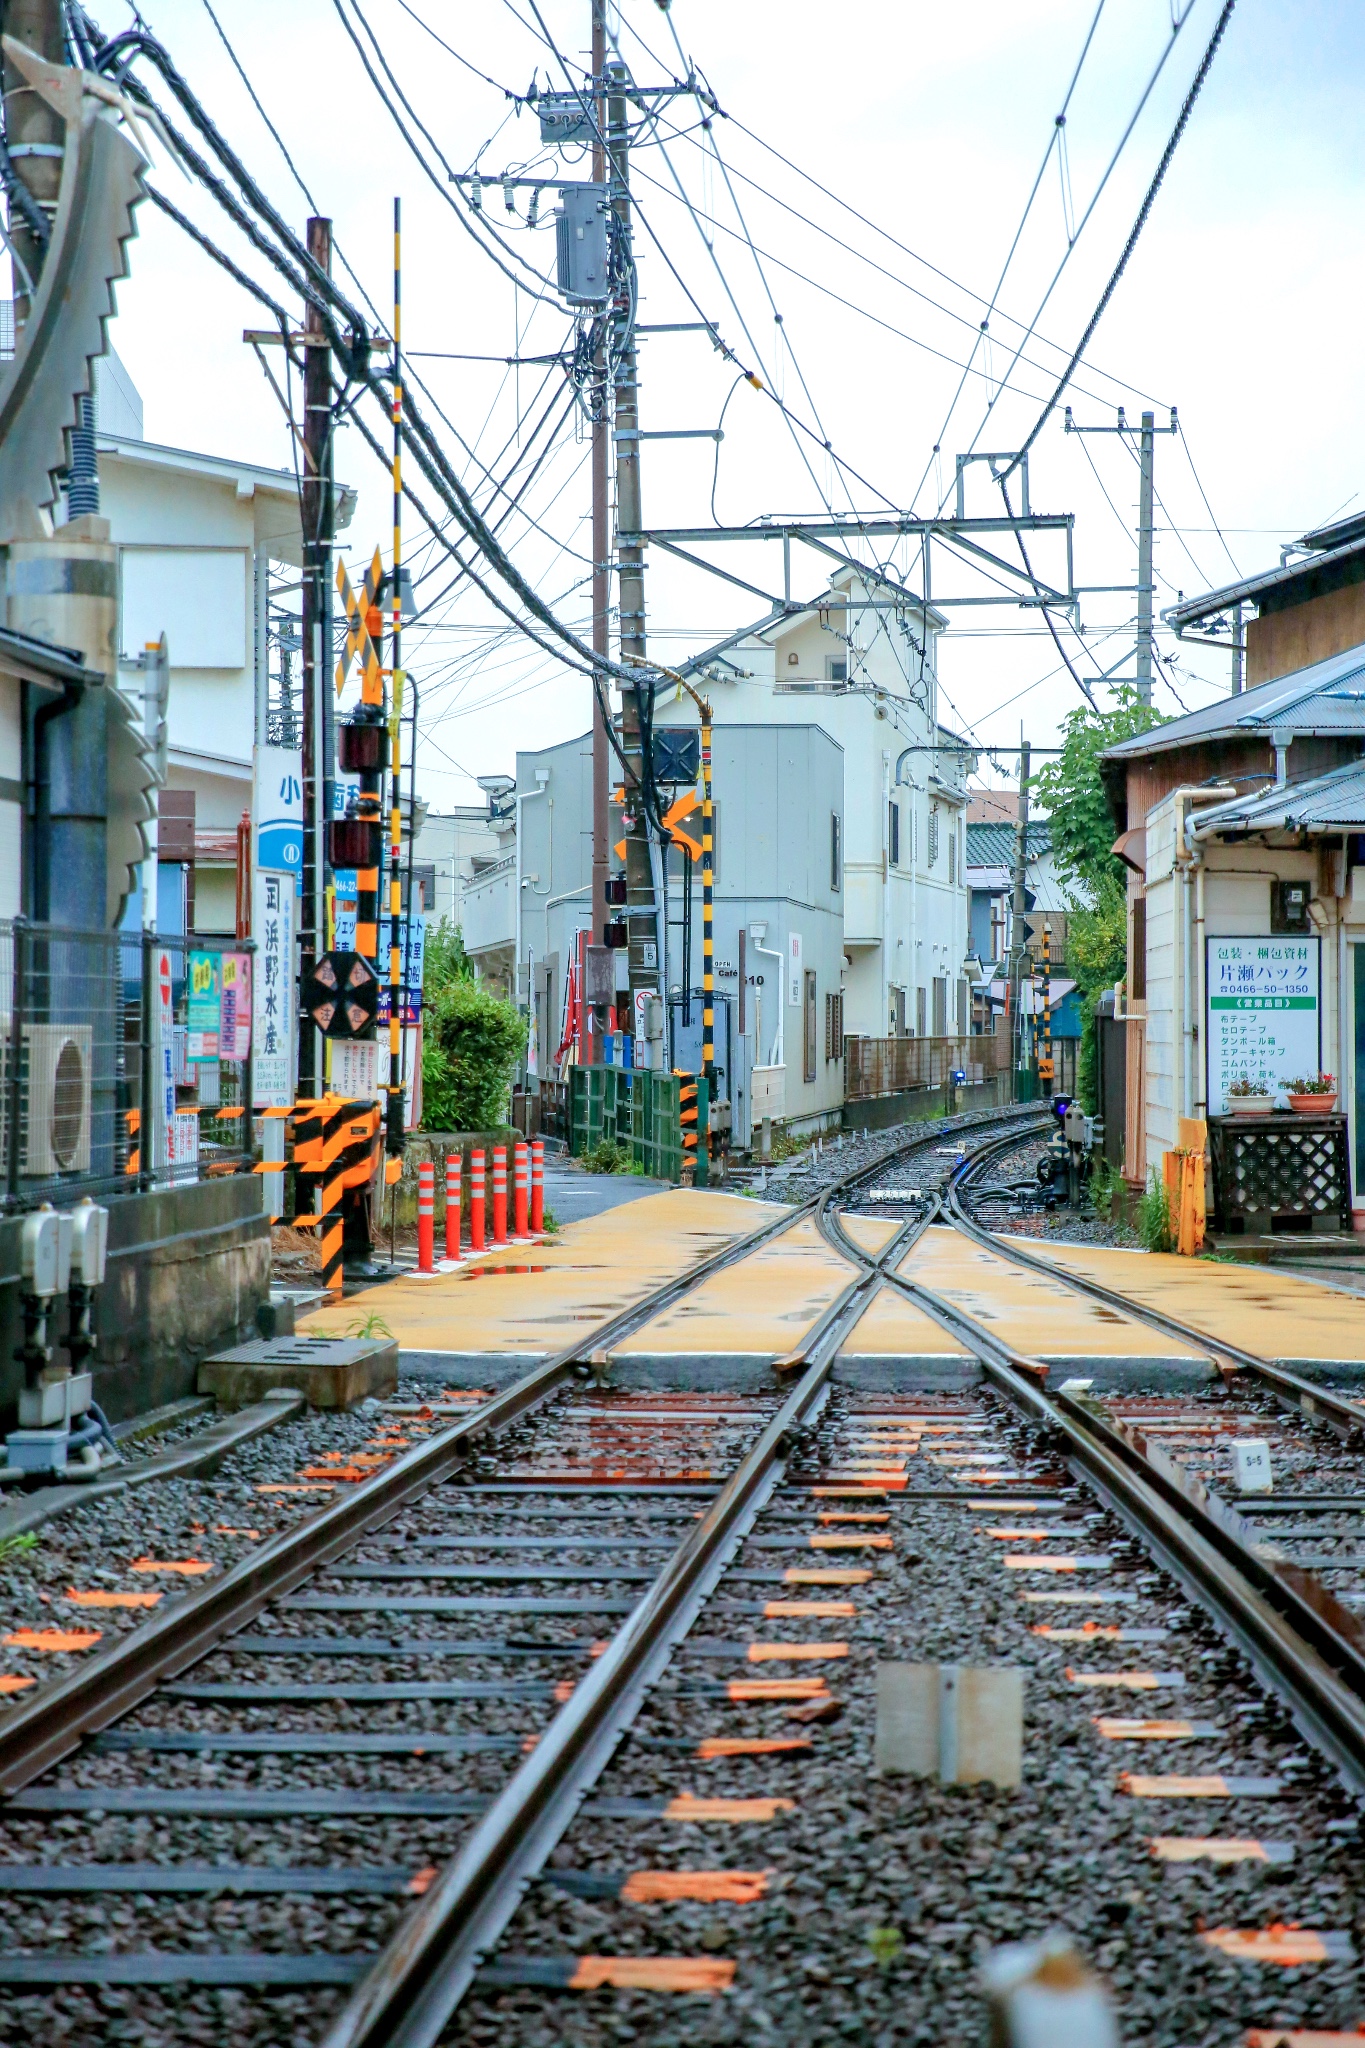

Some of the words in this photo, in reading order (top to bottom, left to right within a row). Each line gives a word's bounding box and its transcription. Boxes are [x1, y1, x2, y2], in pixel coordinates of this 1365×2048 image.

[718, 969, 738, 977] Café
[1220, 964, 1308, 981] 片瀬パック
[1220, 1015, 1257, 1023] 布テープ
[1220, 1026, 1267, 1034] セロテープ
[1221, 1048, 1286, 1056] エアーキャップ
[1221, 1060, 1267, 1068] ゴムバンド
